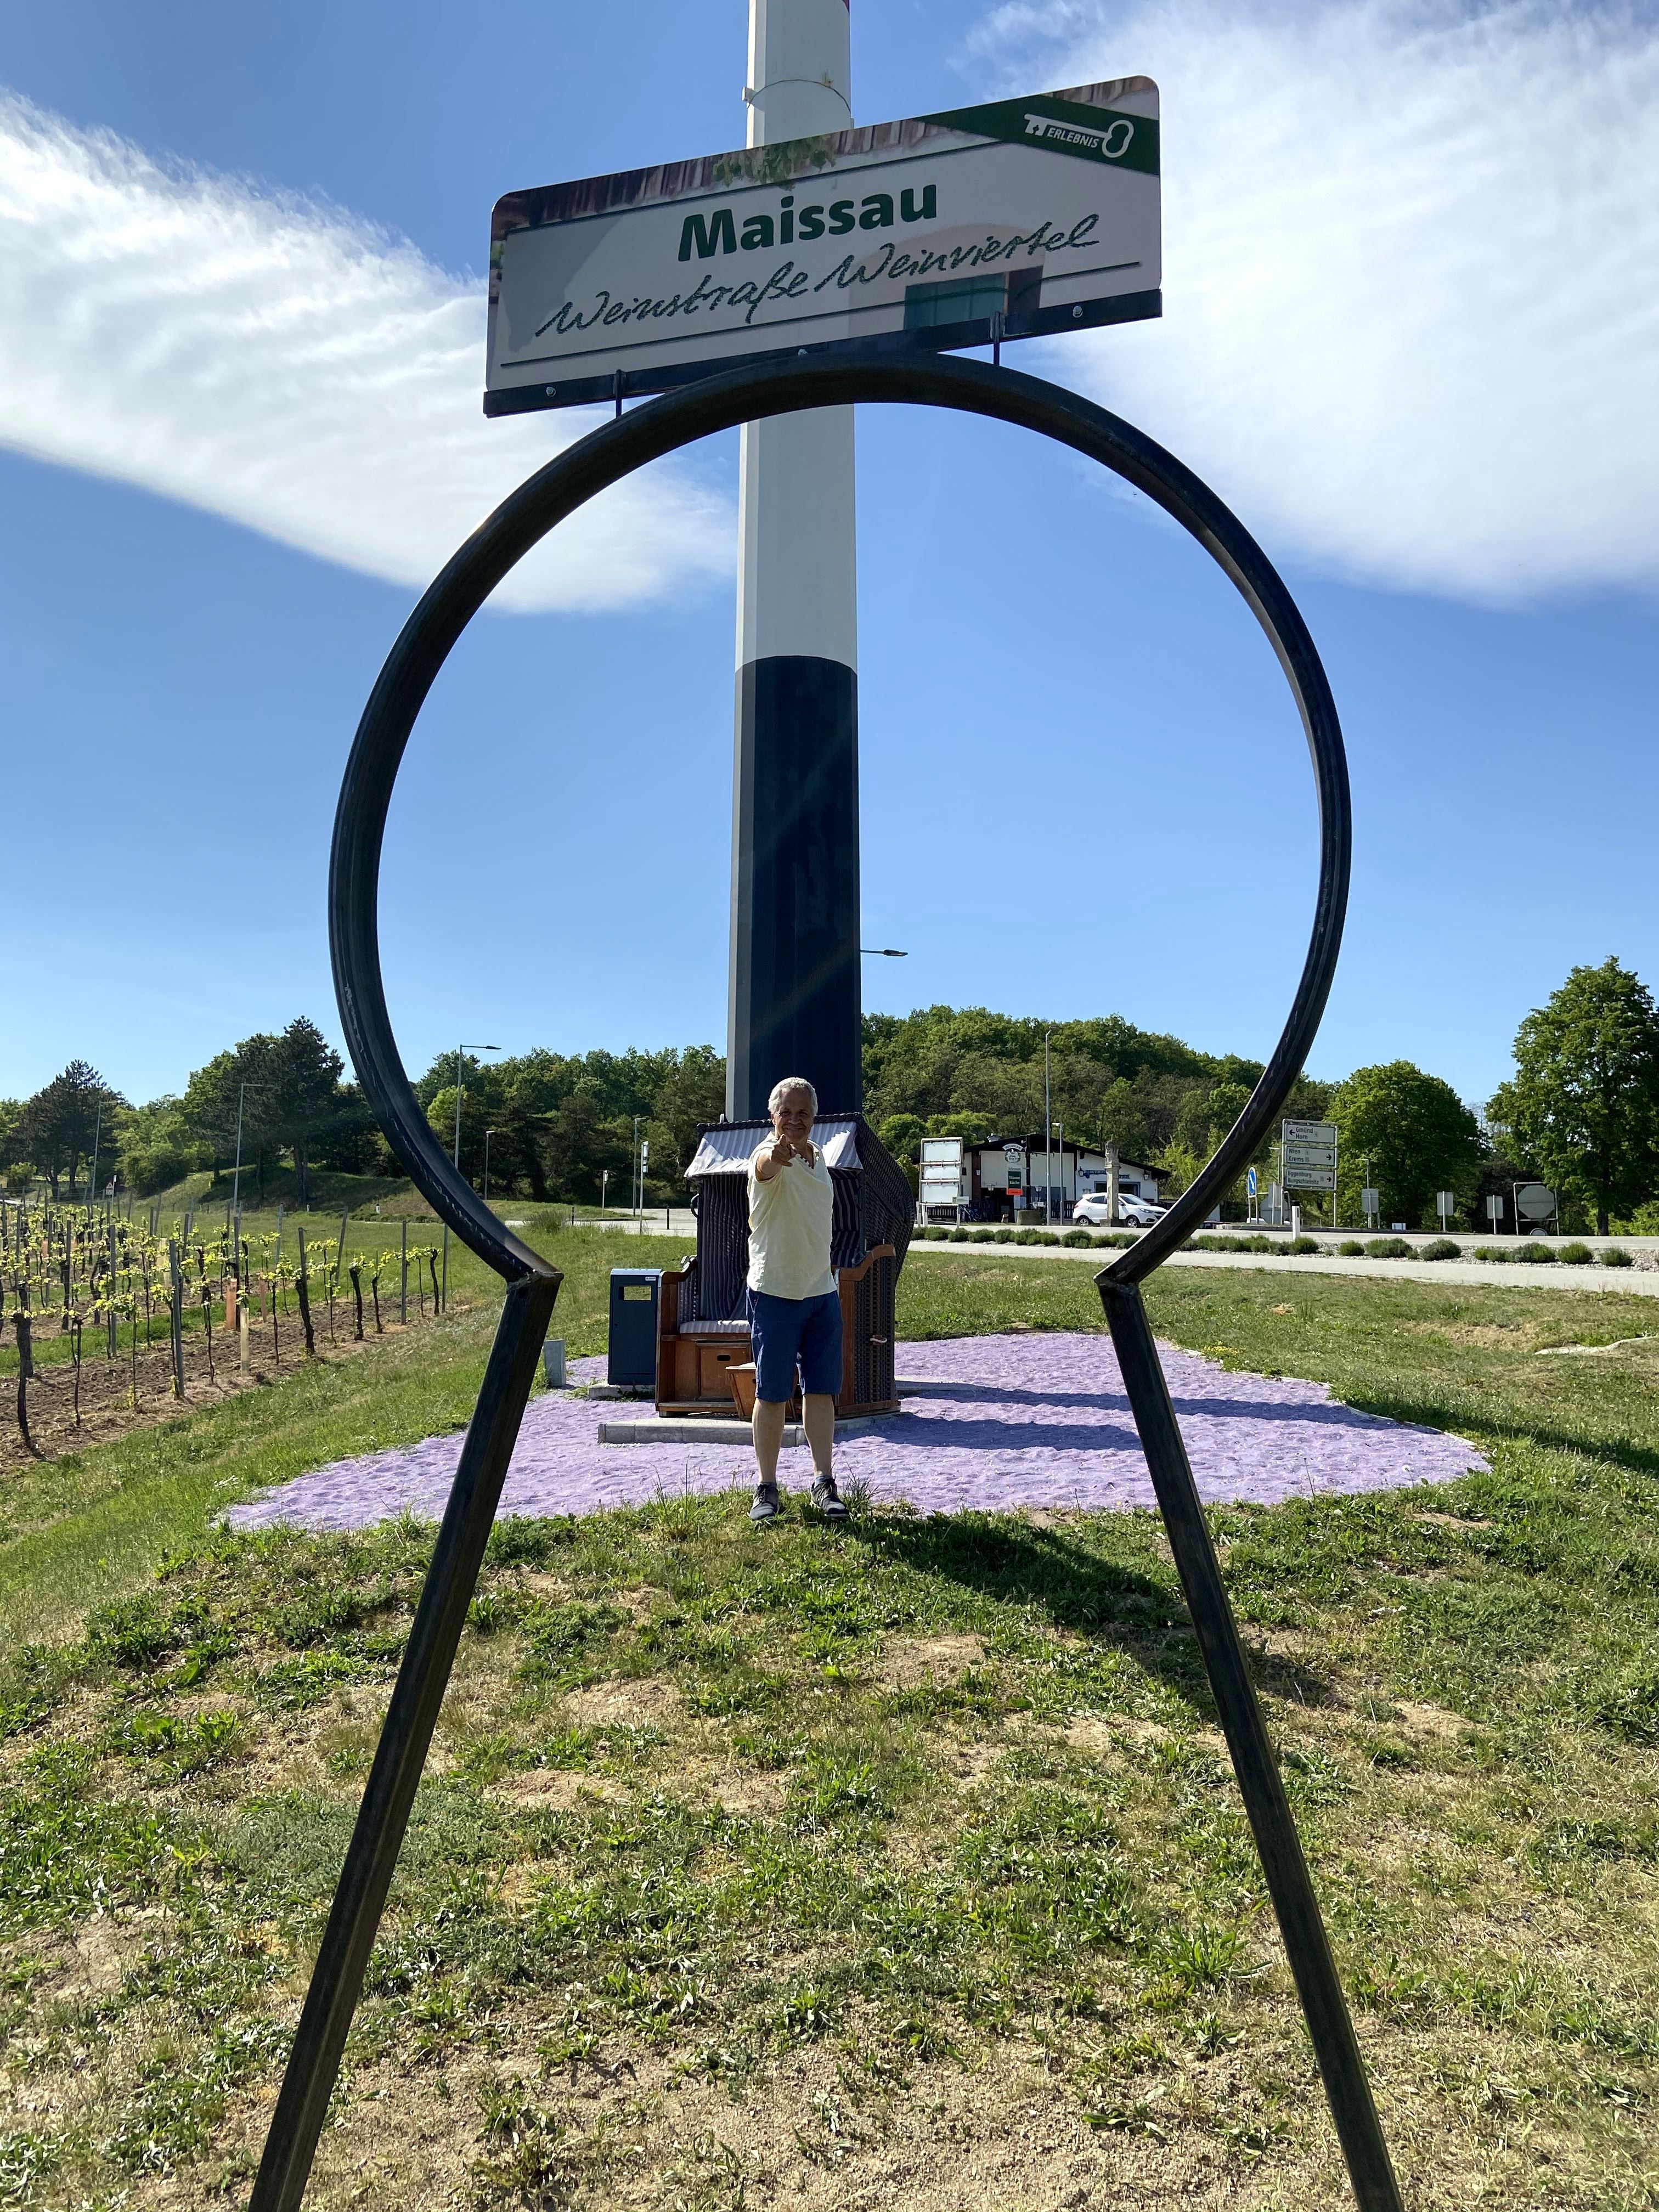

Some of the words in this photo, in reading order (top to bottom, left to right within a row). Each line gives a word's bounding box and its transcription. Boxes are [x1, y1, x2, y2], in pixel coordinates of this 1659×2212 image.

[1047, 127, 1099, 148] ERLEBNIS
[678, 184, 937, 262] Maissau
[535, 261, 809, 337] Weinstraße
[814, 213, 1100, 293] Weinviertel
